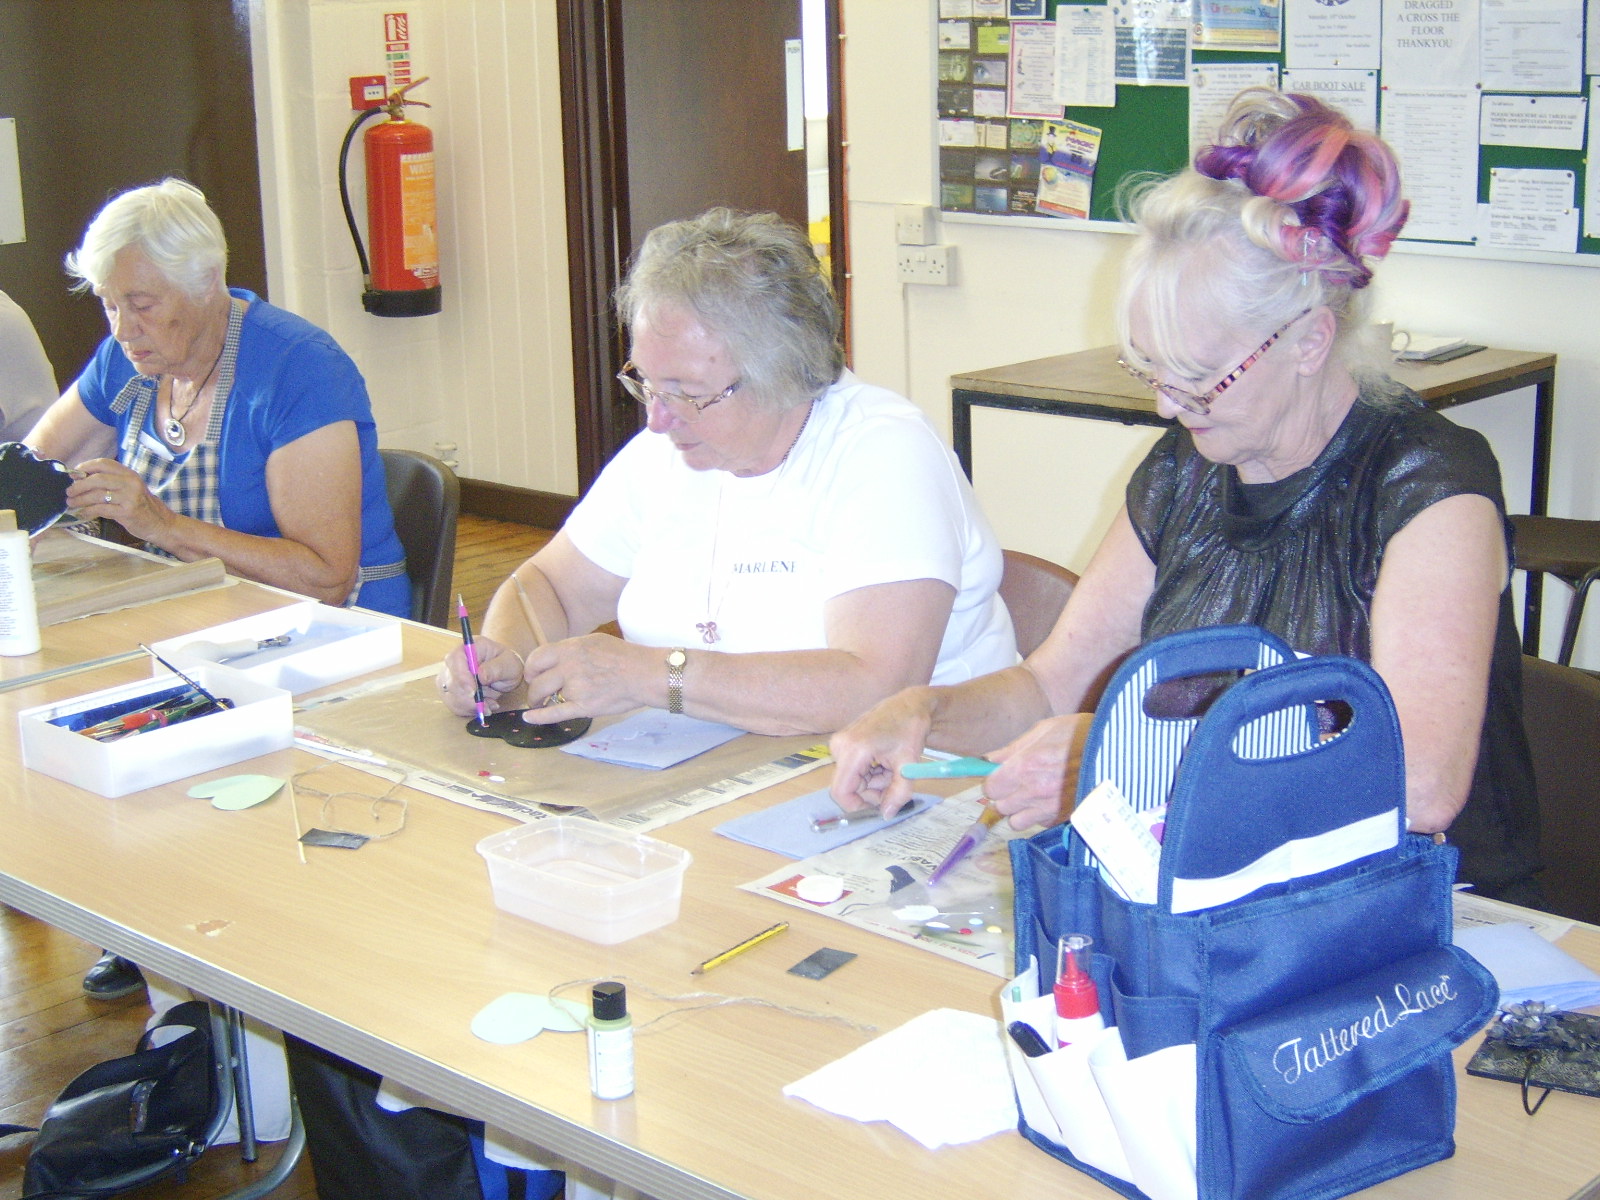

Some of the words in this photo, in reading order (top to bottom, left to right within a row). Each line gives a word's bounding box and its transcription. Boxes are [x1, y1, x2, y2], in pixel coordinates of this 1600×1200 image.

[1404, 0, 1454, 9] DRAGGED
[1396, 14, 1404, 22] A
[1405, 13, 1439, 22] CROSS
[1440, 13, 1461, 22] THE
[1411, 26, 1445, 35] FLOOR
[1396, 38, 1453, 48] THANKYOU
[1292, 80, 1312, 90] CAR
[1313, 80, 1340, 91] BOOT
[1341, 81, 1366, 91] SALE
[1273, 995, 1400, 1085] Tattered
[1395, 981, 1458, 1022] Lace
